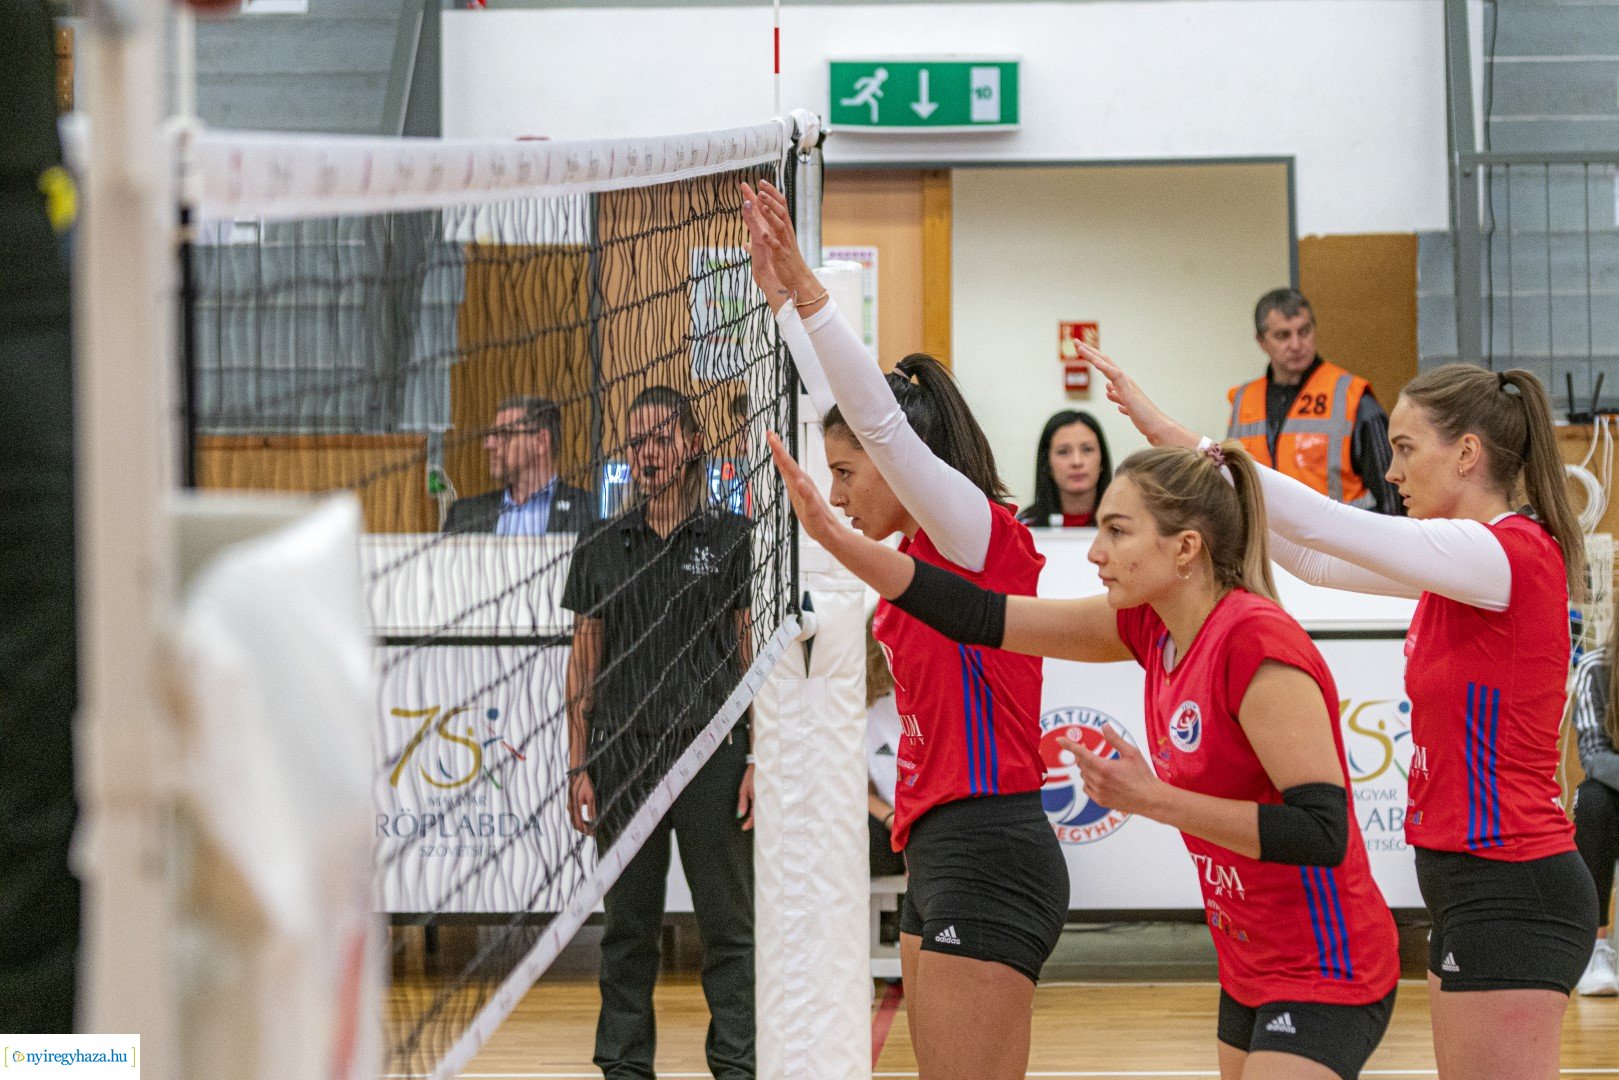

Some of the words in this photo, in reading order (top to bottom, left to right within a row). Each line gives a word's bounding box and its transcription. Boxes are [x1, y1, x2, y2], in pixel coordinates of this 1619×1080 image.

[1299, 394, 1327, 414] 28
[1041, 710, 1107, 731] FATUM
[1352, 788, 1398, 801] AGYAR
[375, 808, 542, 838] RÖPLABDA
[1053, 810, 1128, 840] EGYHA
[935, 935, 961, 945] adidas
